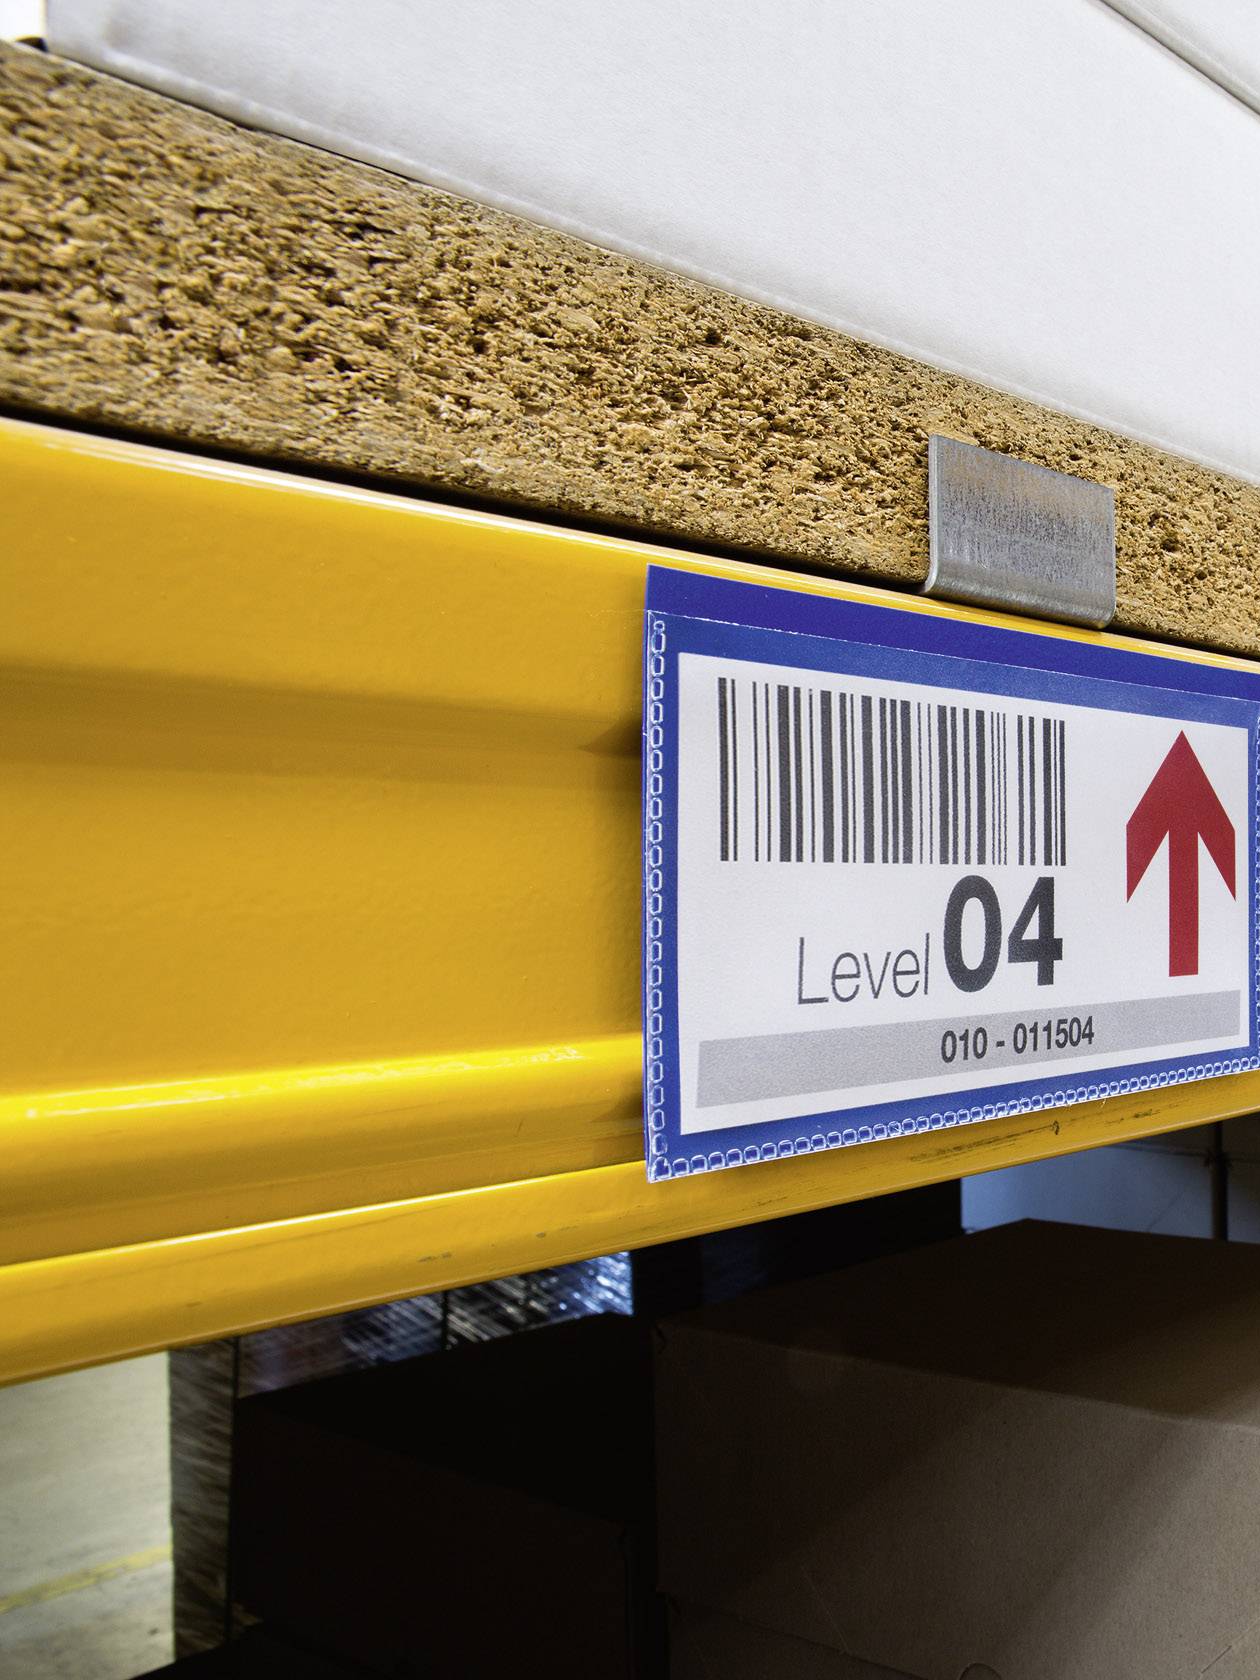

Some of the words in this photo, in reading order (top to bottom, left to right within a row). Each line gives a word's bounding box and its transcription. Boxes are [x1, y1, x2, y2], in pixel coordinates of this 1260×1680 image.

[797, 933, 930, 1006] Level
[943, 874, 1063, 993] 04
[940, 1026, 988, 1063] 010
[1012, 1015, 1096, 1055] 011504
